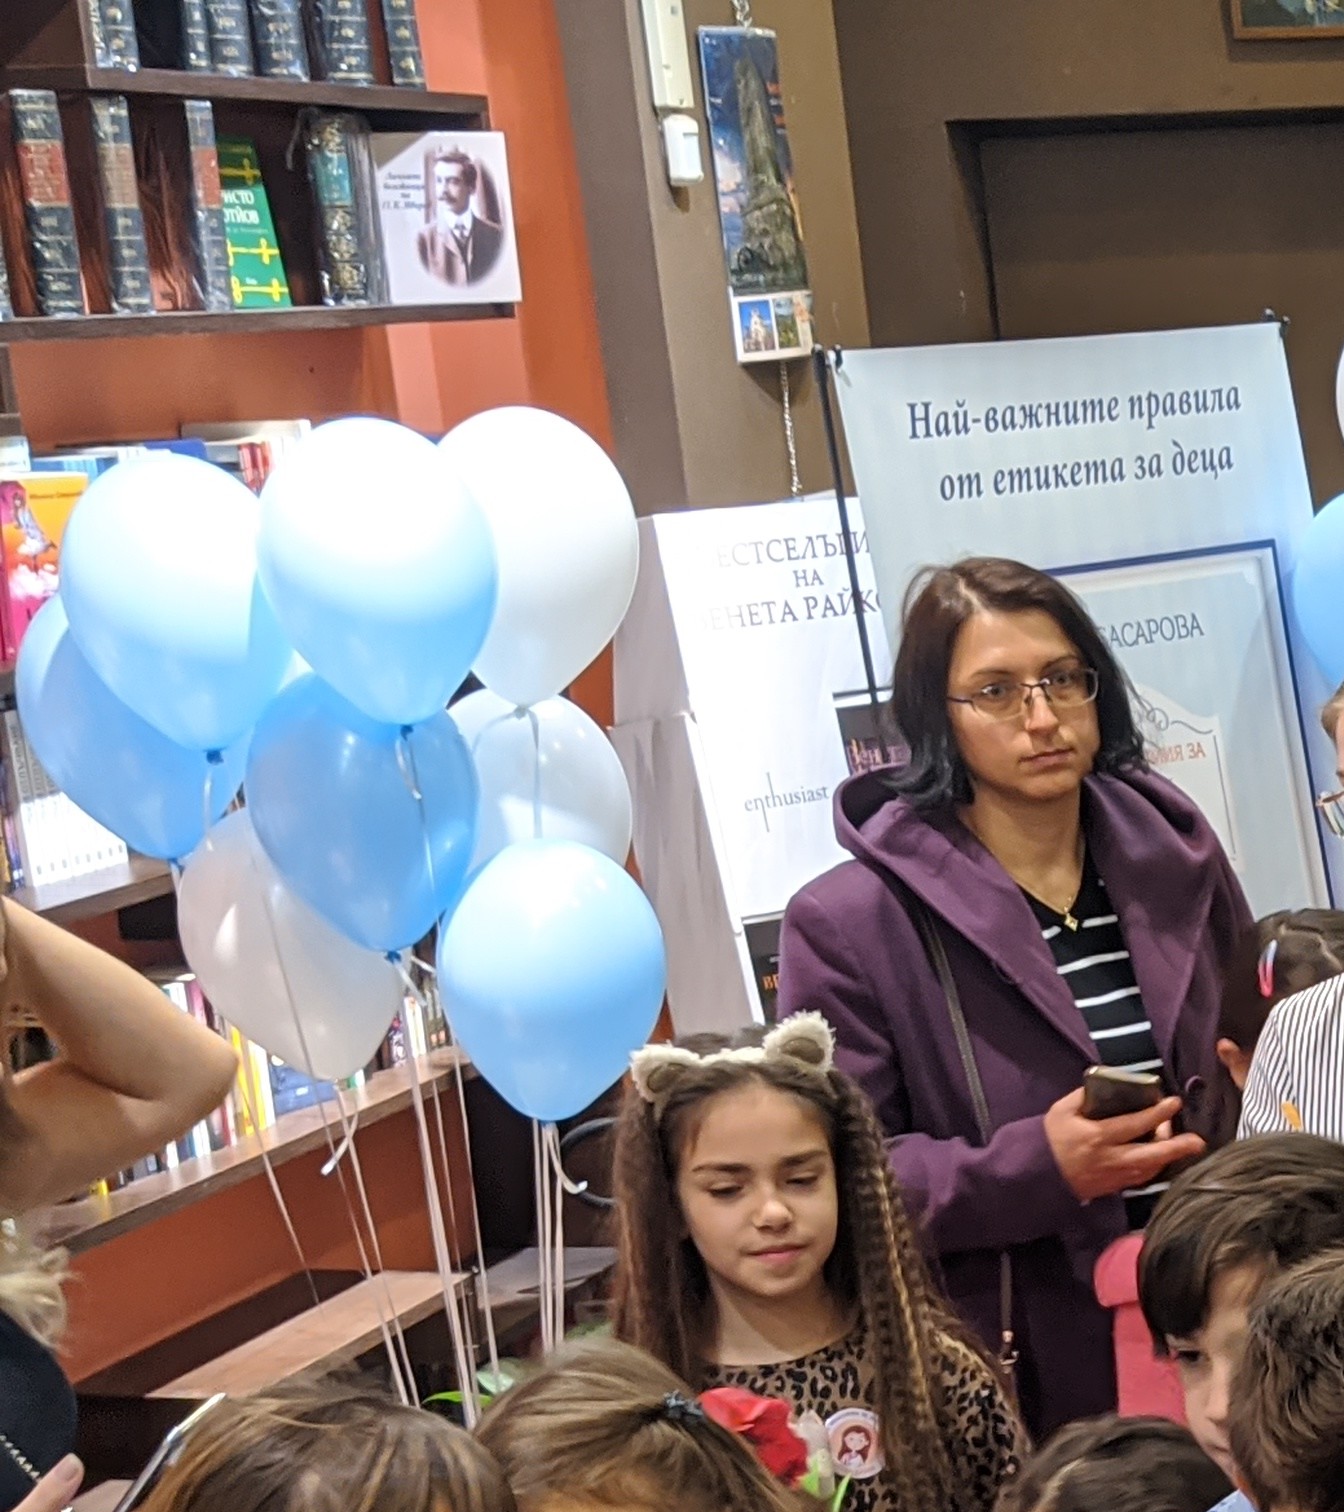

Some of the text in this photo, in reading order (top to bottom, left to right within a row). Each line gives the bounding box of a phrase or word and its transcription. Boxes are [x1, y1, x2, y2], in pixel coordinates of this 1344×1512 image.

[222, 189, 255, 204] ИСТО
[908, 383, 1242, 442] Най-важните правила
[939, 438, 1234, 502] от етикета за деца
[793, 568, 824, 588] НА
[743, 771, 831, 834] enthusiast
